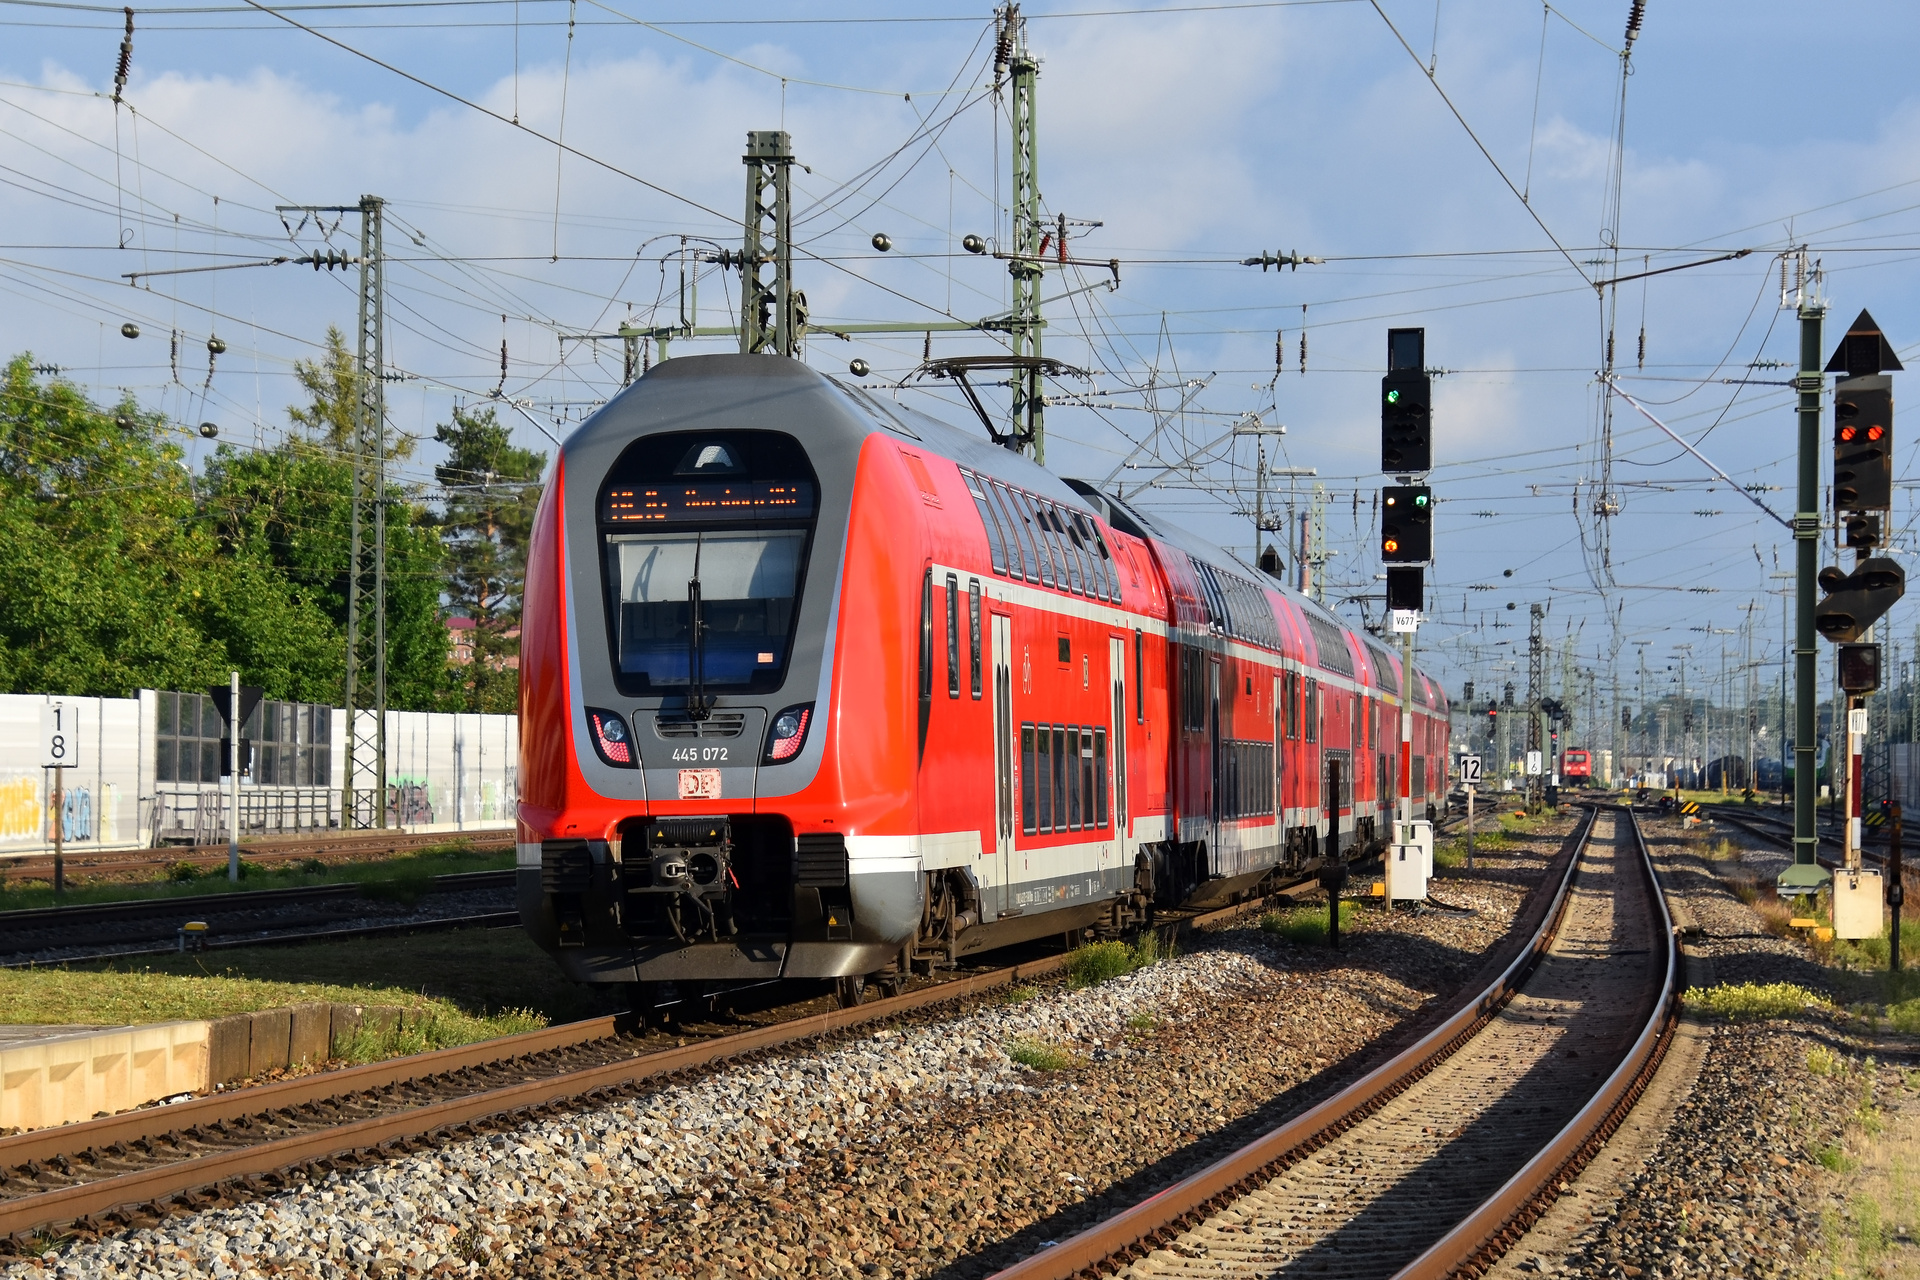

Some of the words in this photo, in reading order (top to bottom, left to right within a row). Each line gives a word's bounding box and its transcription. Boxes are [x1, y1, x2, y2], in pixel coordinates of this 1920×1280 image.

[1396, 616, 1415, 626] V677
[53, 708, 61, 731] 1
[51, 735, 65, 759] 8
[672, 748, 698, 762] 445
[702, 747, 728, 761] 072
[1462, 759, 1480, 779] 12
[1531, 763, 1538, 772] 6
